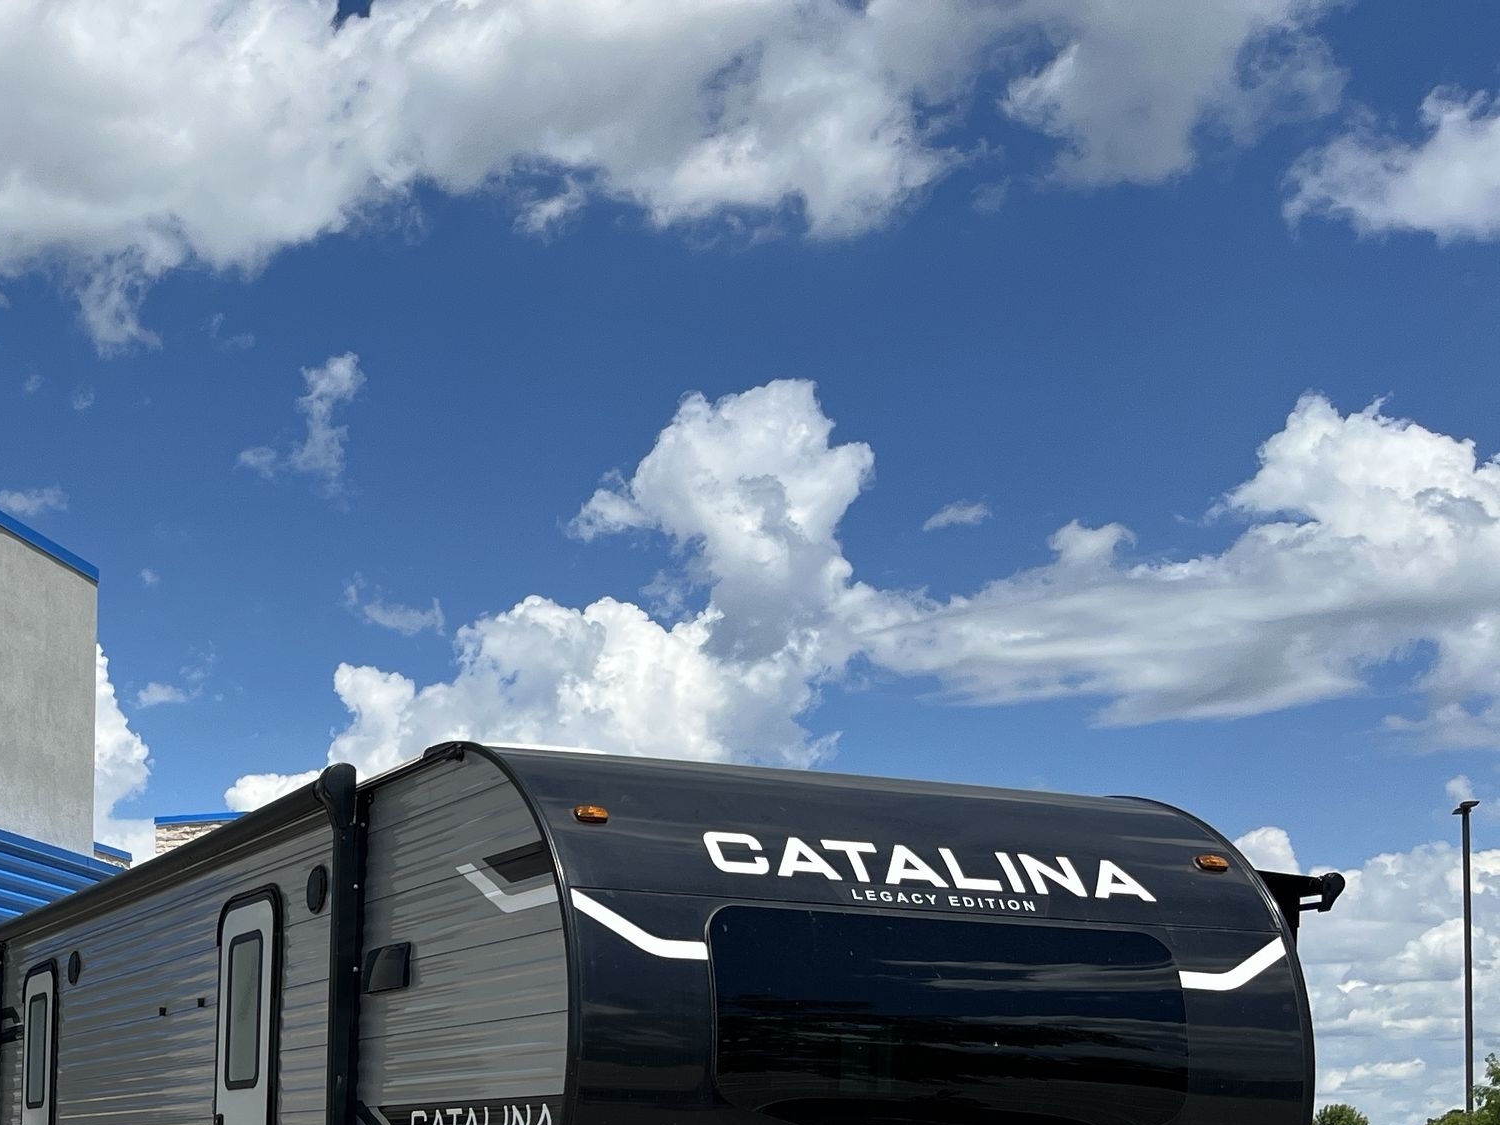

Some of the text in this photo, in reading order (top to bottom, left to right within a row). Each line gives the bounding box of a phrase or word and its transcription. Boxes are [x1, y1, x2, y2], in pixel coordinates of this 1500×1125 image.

[703, 831, 1157, 902] CATALINA
[851, 888, 1037, 913] LEGACY EDITION
